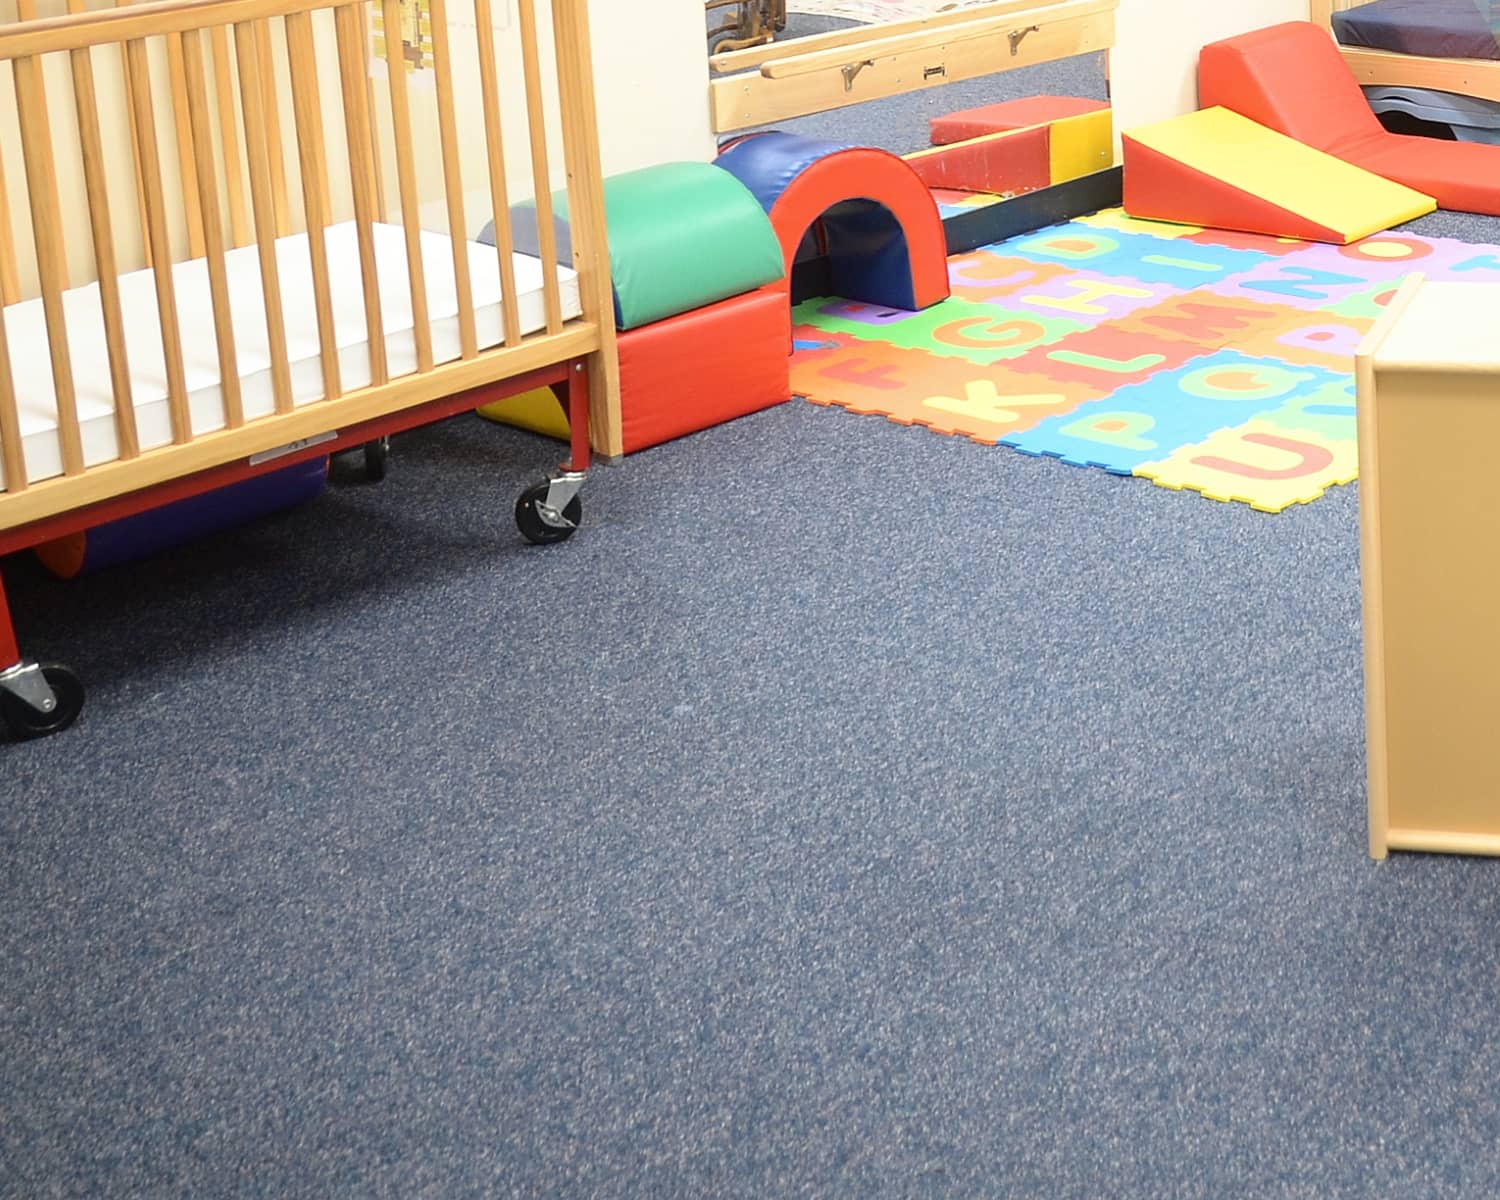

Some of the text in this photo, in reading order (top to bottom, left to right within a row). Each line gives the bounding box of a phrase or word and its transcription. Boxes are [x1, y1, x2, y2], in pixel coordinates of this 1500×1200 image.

[1016, 234, 1120, 261] D
[1338, 237, 1434, 263] O
[948, 260, 1035, 288] C
[1020, 279, 1154, 315] H
[931, 317, 1046, 349] G
[1141, 303, 1278, 341] M
[816, 357, 906, 390] F
[1046, 350, 1166, 373] L
[1178, 363, 1317, 400] Q
[922, 380, 1066, 423] K
[1057, 411, 1157, 451] P
[1189, 432, 1334, 481] U
